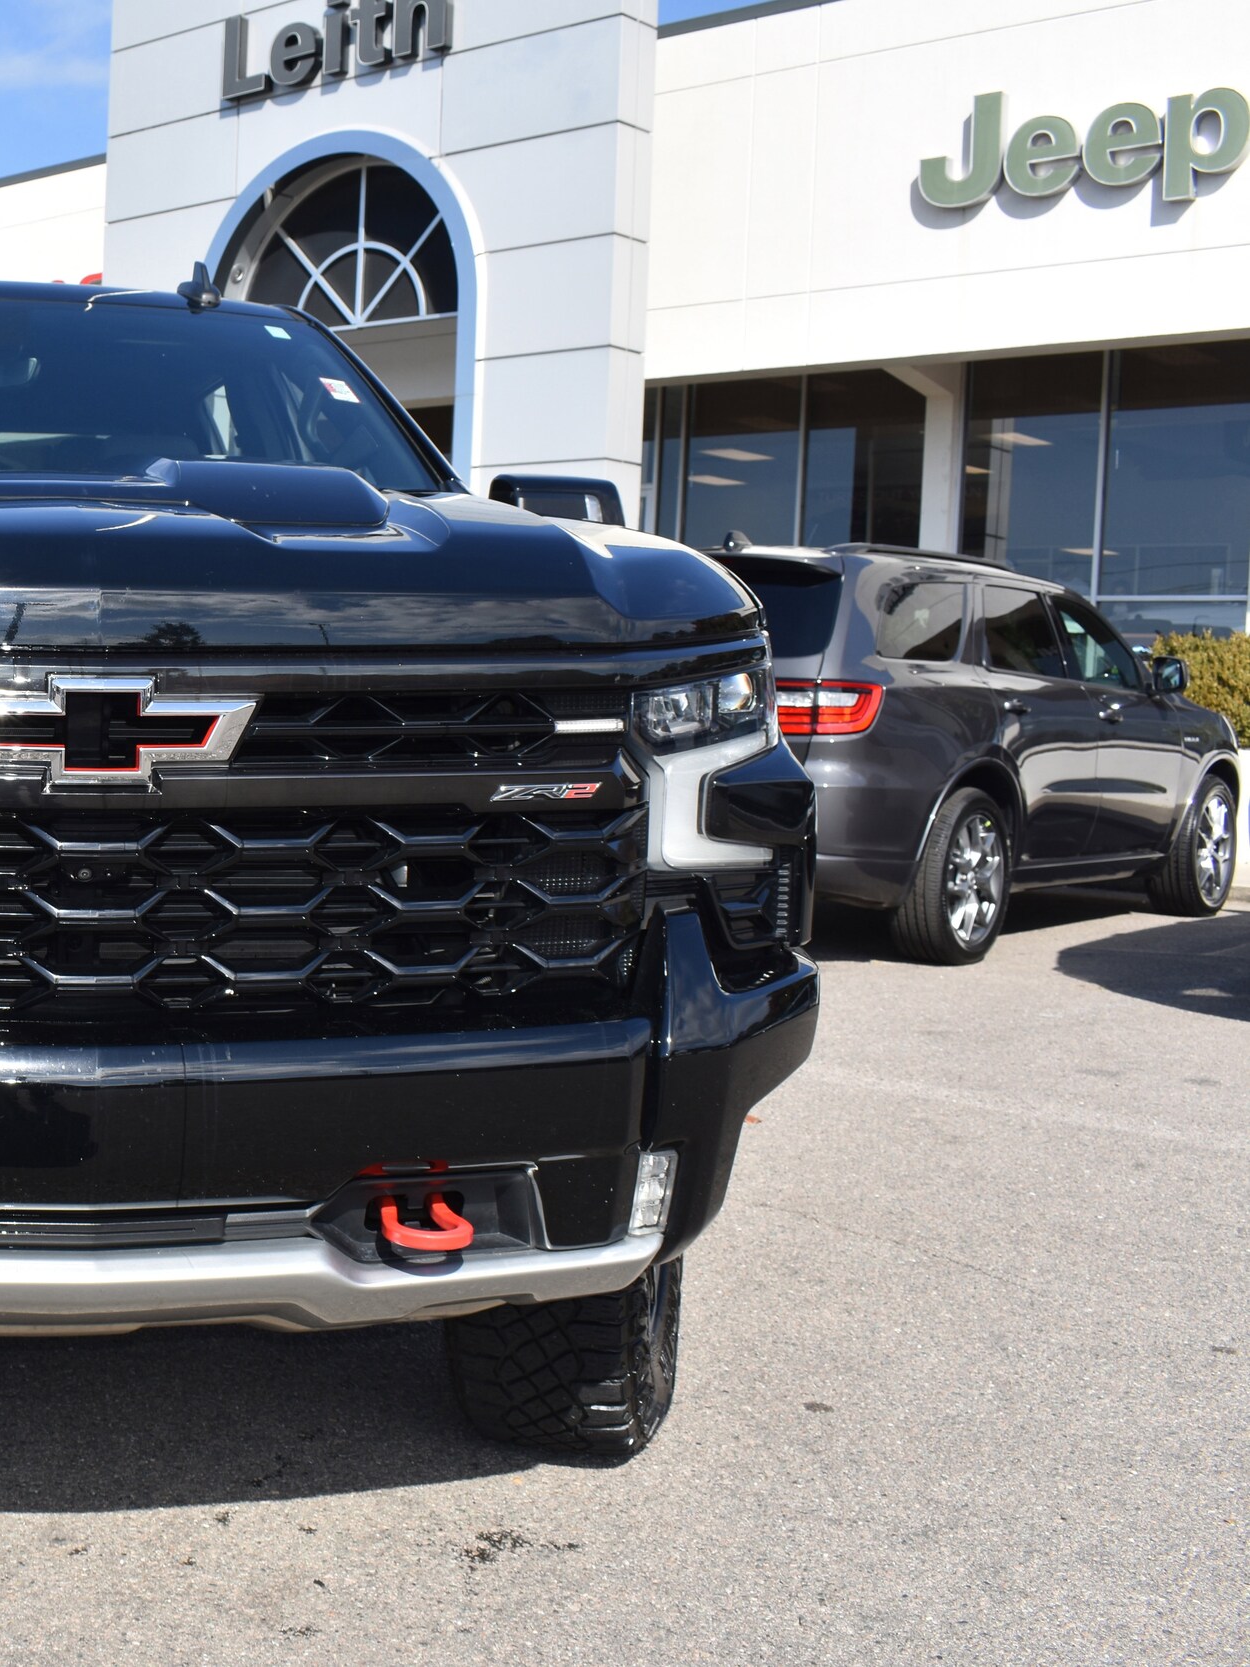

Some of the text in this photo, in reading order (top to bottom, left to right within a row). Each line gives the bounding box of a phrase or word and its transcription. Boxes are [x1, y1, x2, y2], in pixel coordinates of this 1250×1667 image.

[222, 0, 452, 102] Leith
[918, 86, 1250, 209] Jeep
[490, 782, 602, 801] ZR2
